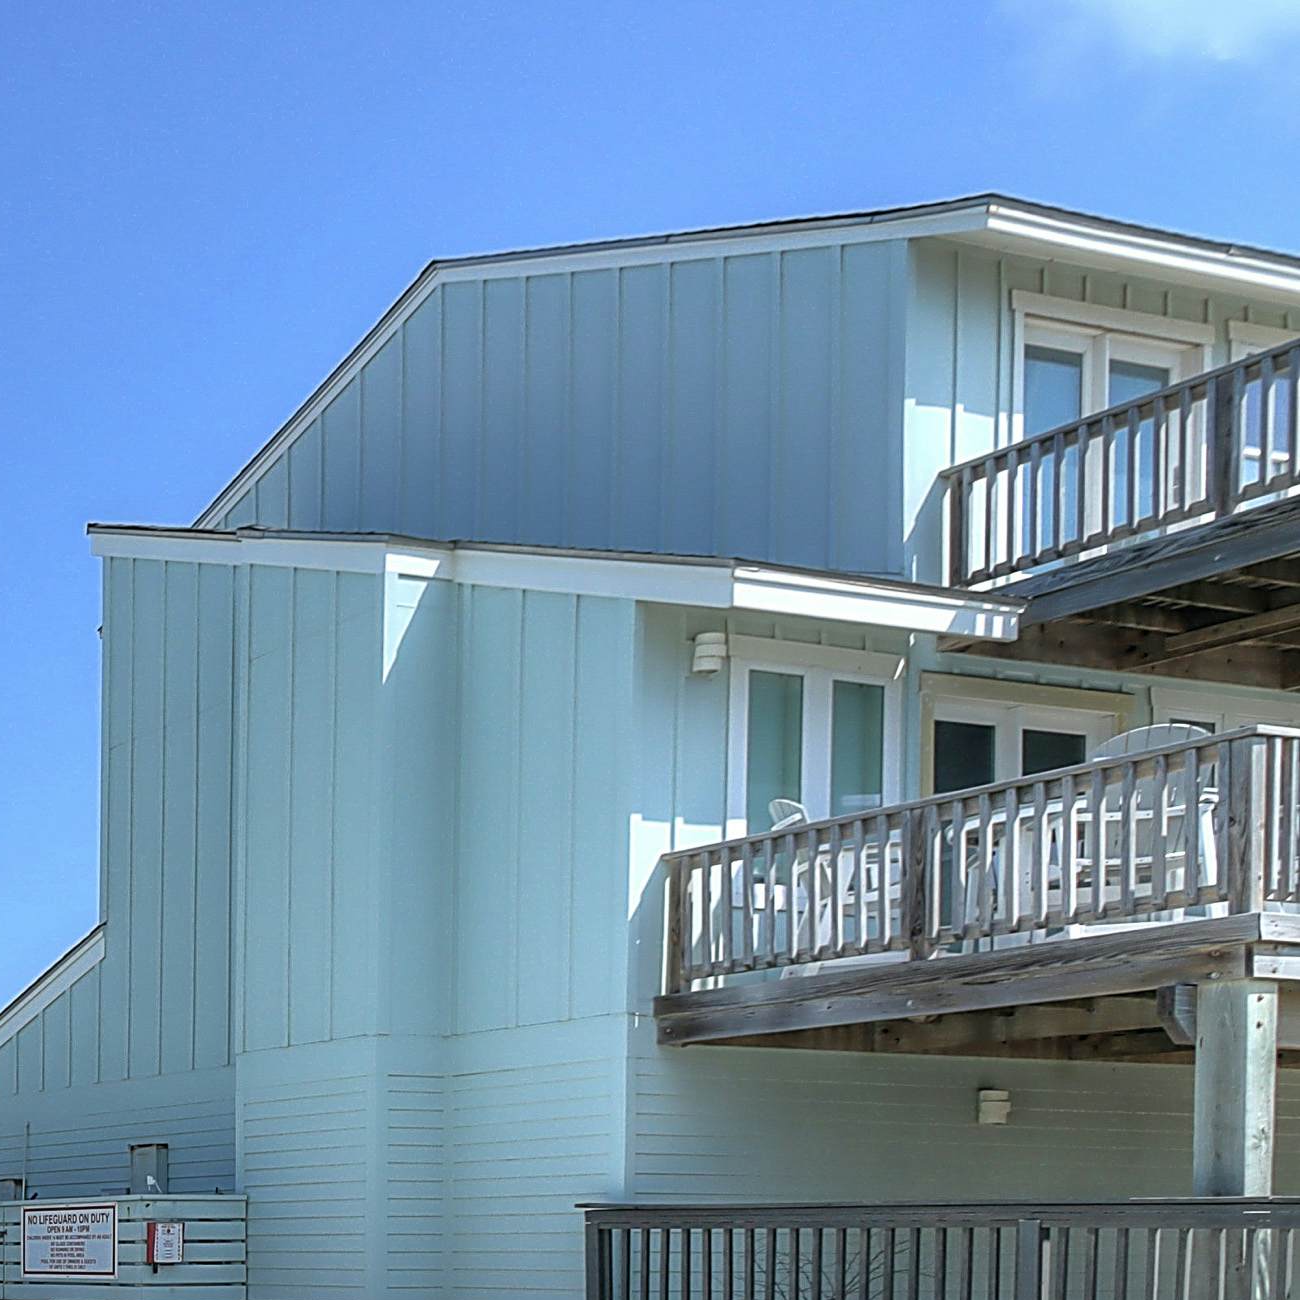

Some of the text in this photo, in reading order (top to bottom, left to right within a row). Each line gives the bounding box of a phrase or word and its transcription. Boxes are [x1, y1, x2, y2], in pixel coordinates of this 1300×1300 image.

[28, 1212, 110, 1225] NO LIFEGUARD ON DUTY
[65, 1225, 73, 1233] AM
